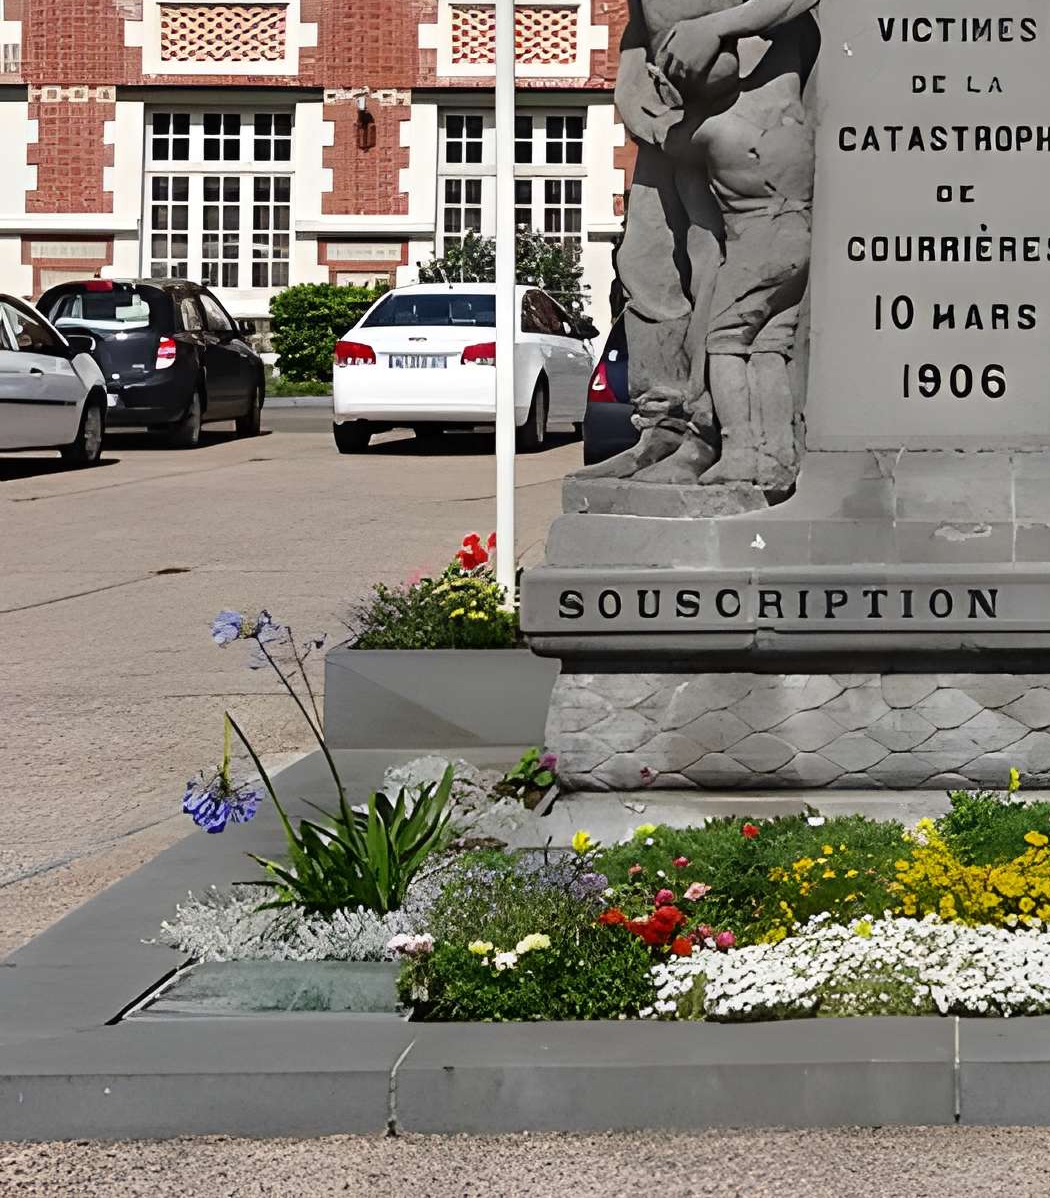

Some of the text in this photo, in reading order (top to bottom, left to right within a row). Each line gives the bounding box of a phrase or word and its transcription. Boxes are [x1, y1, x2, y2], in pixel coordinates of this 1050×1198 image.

[877, 17, 1037, 43] VICTIMES
[966, 75, 1003, 93] LA
[875, 294, 1037, 331] 10 MARS
[903, 363, 1007, 399] 1906
[558, 588, 999, 620] SOUSCRIPTION
